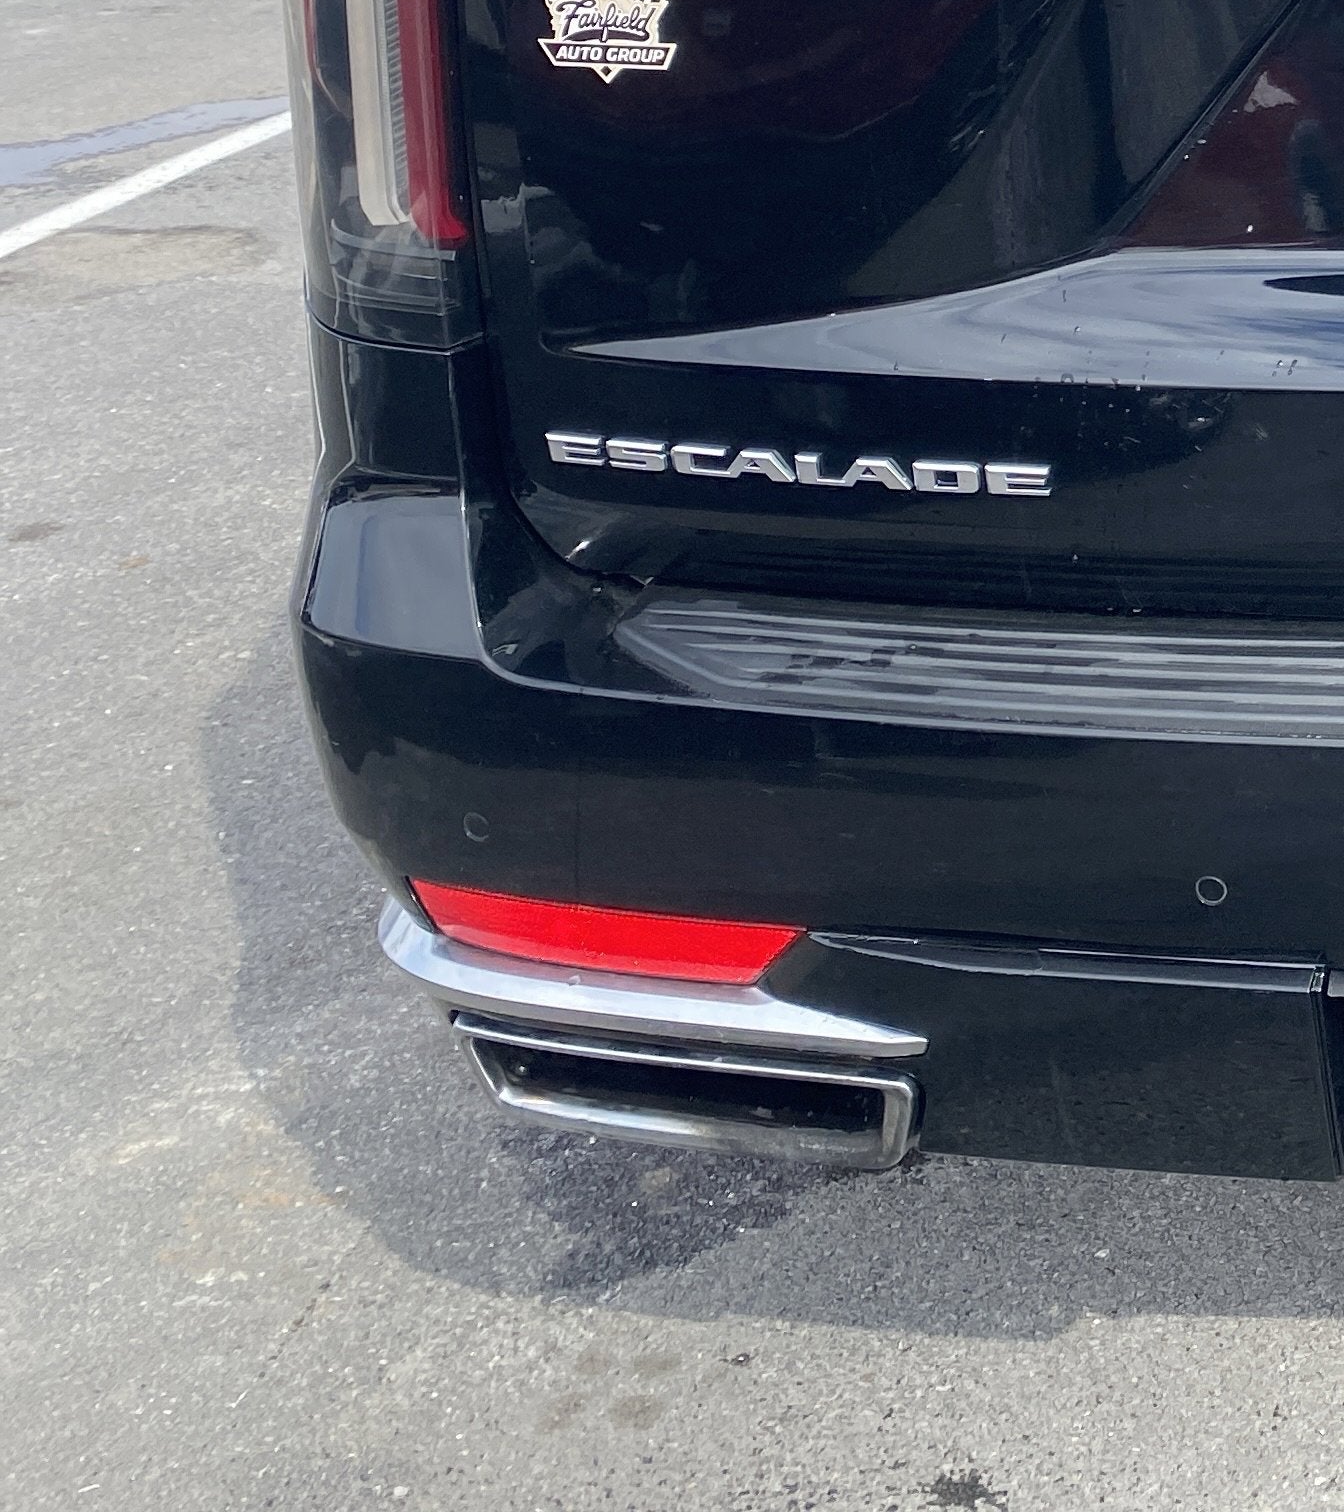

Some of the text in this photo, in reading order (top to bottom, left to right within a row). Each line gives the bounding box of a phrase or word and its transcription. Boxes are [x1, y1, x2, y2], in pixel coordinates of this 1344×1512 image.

[556, 0, 656, 42] Fairfield
[556, 45, 665, 63] AUTO GROUP
[544, 431, 1051, 497] ESCALADE
